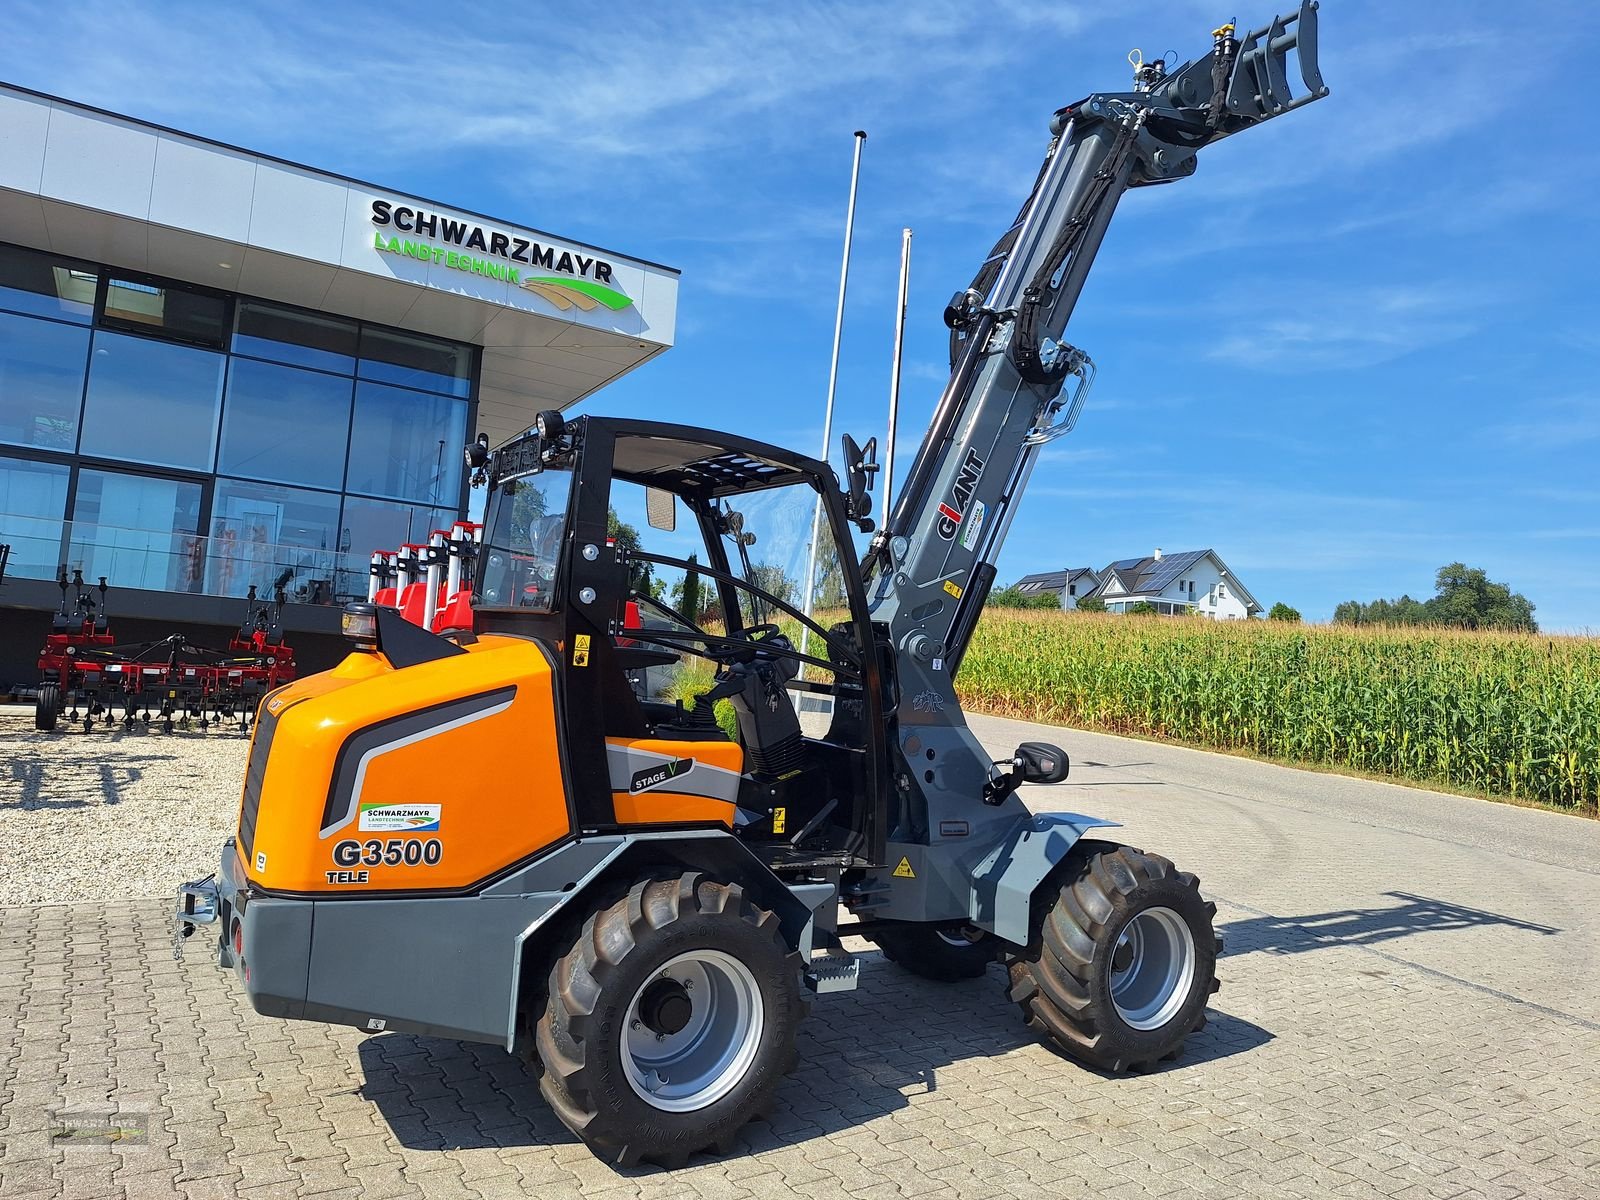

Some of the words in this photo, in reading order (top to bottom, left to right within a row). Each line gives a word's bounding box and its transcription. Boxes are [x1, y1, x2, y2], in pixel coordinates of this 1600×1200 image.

[371, 200, 613, 284] SCHWARZMAYR
[374, 231, 521, 284] LANDTECHNIK
[937, 446, 985, 541] GIANT
[635, 771, 667, 789] STAGE
[668, 756, 678, 776] V
[332, 838, 442, 868] G3500
[326, 870, 369, 884] TELE
